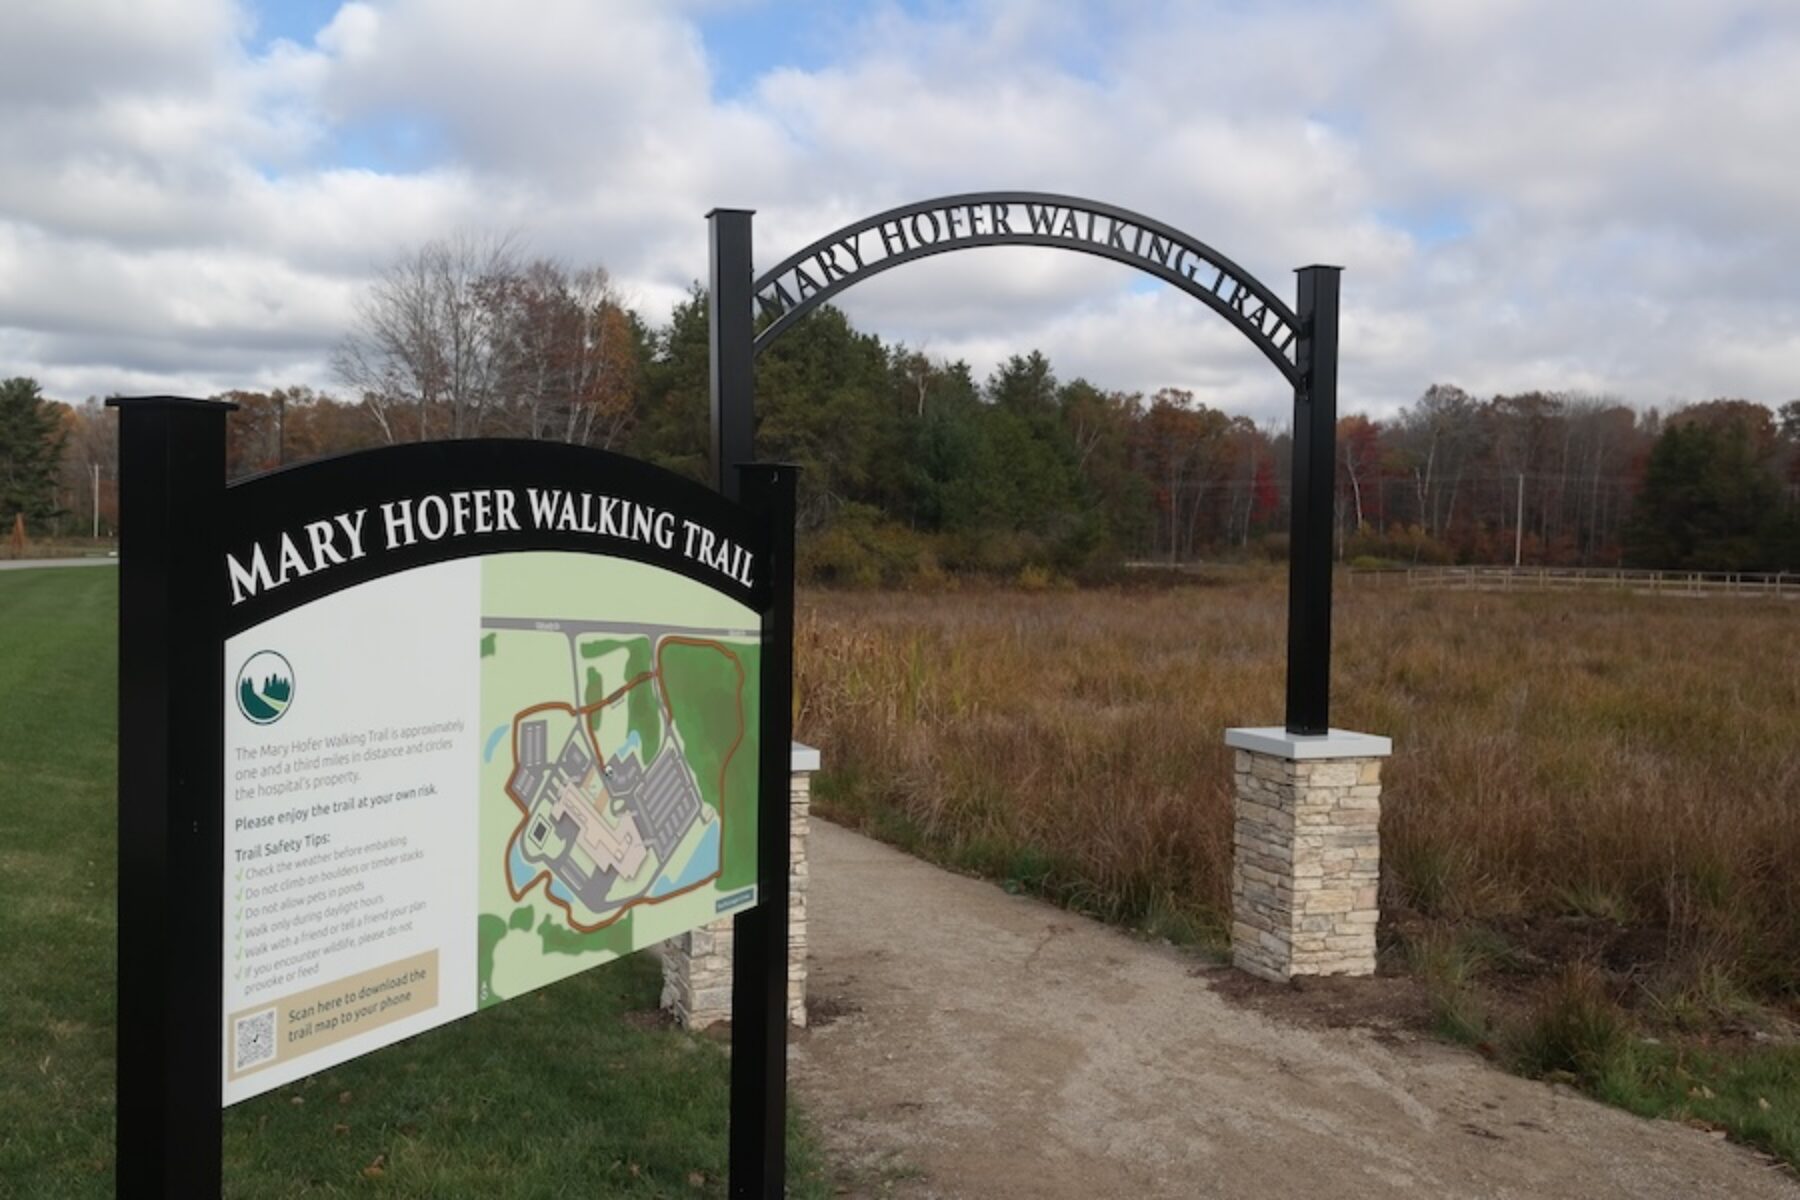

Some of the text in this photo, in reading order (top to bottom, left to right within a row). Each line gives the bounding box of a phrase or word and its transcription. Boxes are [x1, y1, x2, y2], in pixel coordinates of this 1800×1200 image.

[754, 202, 1302, 358] MARY HOFER WALKING TRAIL
[225, 487, 755, 605] MARY HOFER WALKING TRAIL
[235, 717, 464, 760] The Mary Hofer Walking Trail is approximately
[235, 738, 453, 781] one and a third miles in distance and circles
[235, 787, 255, 801] the
[235, 816, 275, 831] Please
[277, 807, 309, 824] enjoy
[311, 803, 330, 817] the
[333, 797, 355, 813] trail
[358, 795, 369, 809] at
[370, 791, 393, 809] your
[395, 788, 416, 802] own
[235, 832, 330, 862] Trail Safety Tips:
[245, 835, 408, 880] Check the weather before embarking
[245, 887, 260, 900] Do
[262, 882, 279, 896] not
[280, 876, 306, 892] climb
[307, 873, 319, 885] on
[320, 864, 358, 882] boulders
[360, 862, 370, 873] or
[399, 848, 424, 863] stacks
[245, 880, 364, 920] Do not allow pets in ponds
[245, 894, 384, 939] Walk only during daylight hours
[245, 942, 268, 959] Walk
[270, 935, 291, 951] with
[293, 935, 299, 946] a
[301, 925, 328, 941] friend
[329, 923, 340, 936] or
[341, 916, 356, 932] tell
[357, 917, 363, 928] a
[364, 908, 389, 924] friend
[390, 904, 408, 922] your
[253, 962, 273, 979] you
[273, 947, 321, 970] encounter
[358, 930, 385, 947] please
[386, 925, 398, 938] do
[399, 921, 414, 933] not
[244, 961, 320, 996] provoke or feed
[288, 969, 427, 1024] Scan here to download the
[288, 990, 412, 1043] trail map to your phone
